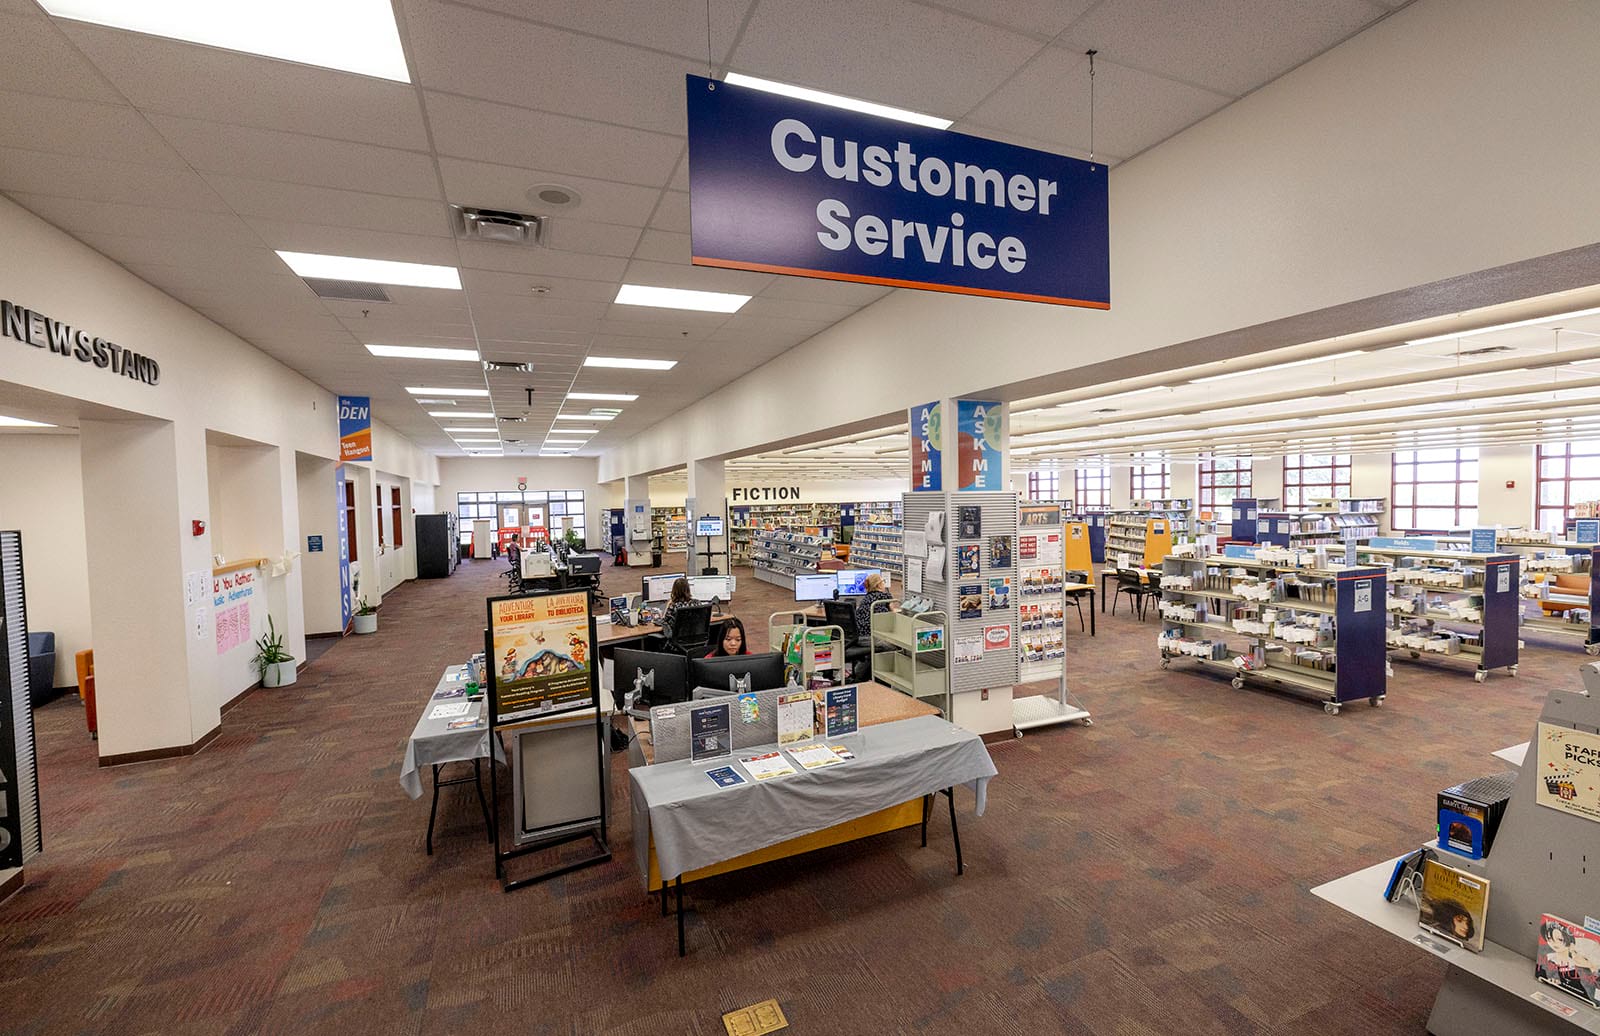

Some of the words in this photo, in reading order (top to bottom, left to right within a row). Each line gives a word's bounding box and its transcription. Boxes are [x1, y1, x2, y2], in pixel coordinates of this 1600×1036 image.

[770, 118, 1058, 216] Customer
[815, 198, 1028, 275] Service
[0, 299, 161, 386] NEWSSTAND
[340, 406, 369, 420] DEN
[920, 408, 932, 452] ASK
[973, 405, 988, 451] ASK
[341, 441, 357, 450] Teen
[344, 446, 370, 457] Hangout
[922, 459, 933, 488] ME
[973, 459, 988, 488] ME
[732, 486, 800, 501] FICTION
[338, 480, 350, 617] TEENS
[499, 600, 535, 614] ADVENTURE
[546, 598, 554, 609] LA
[547, 609, 555, 617] TU
[555, 606, 585, 616] BIBLIOTECA
[500, 615, 514, 623] YOUR
[514, 613, 535, 621] LIBRARY
